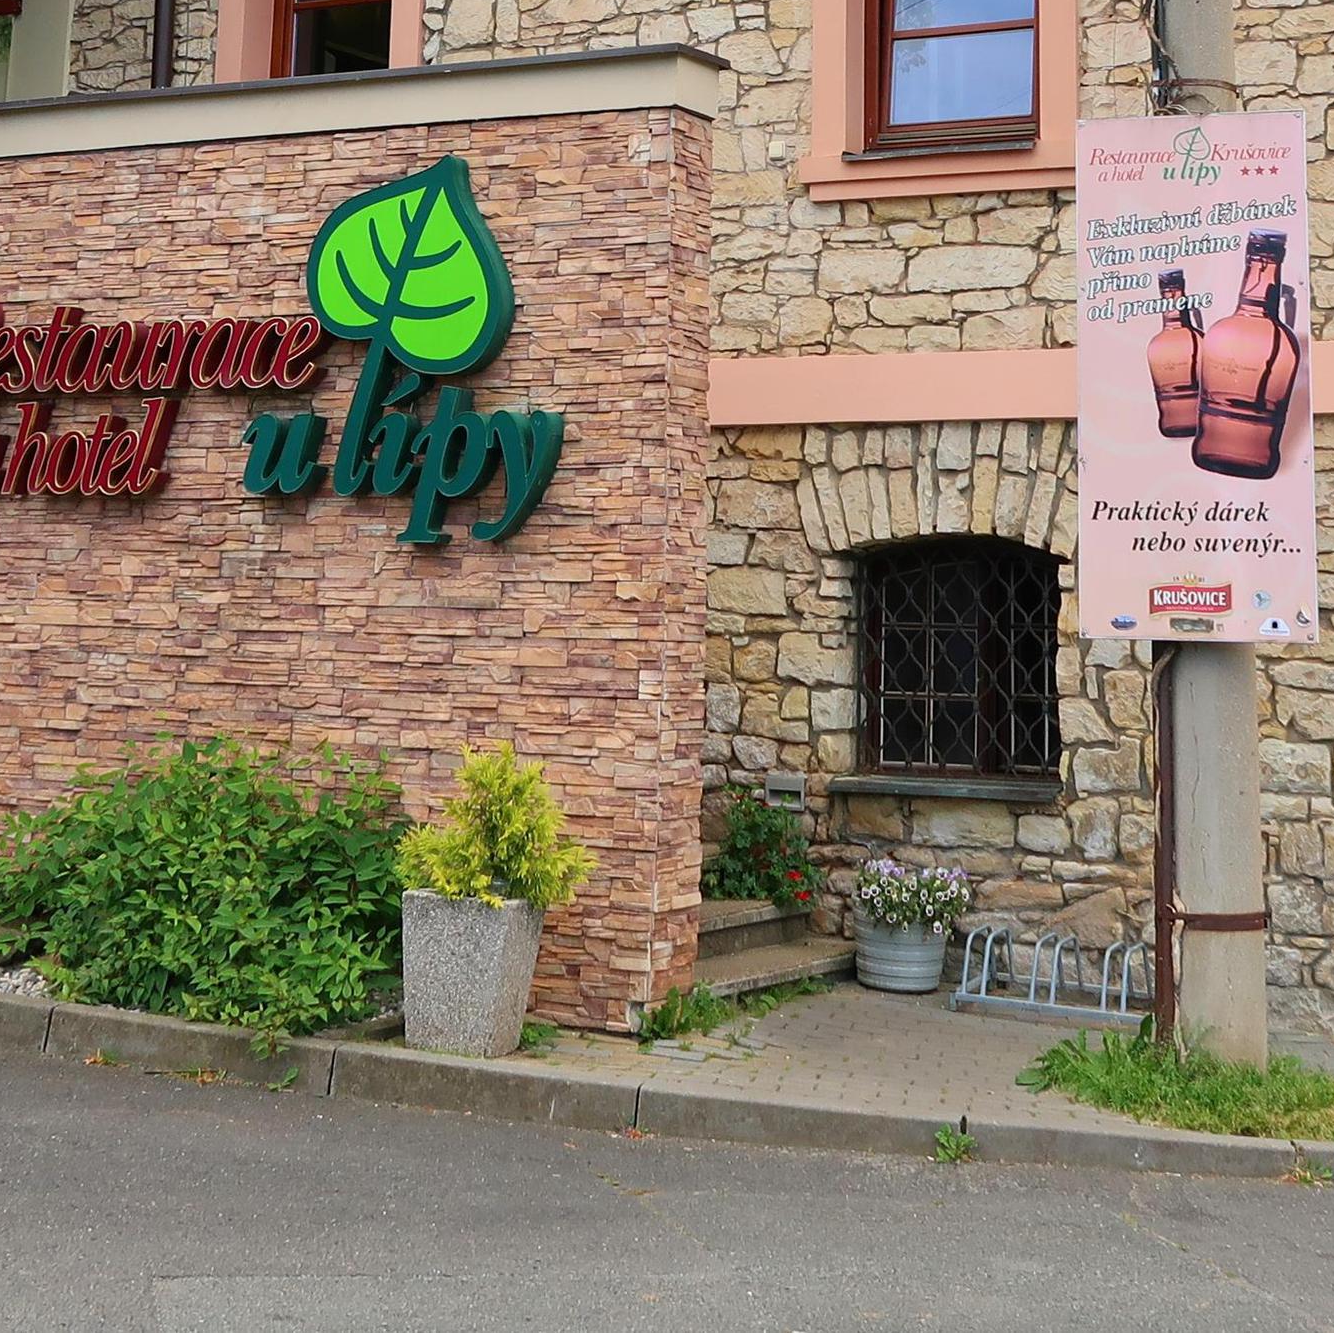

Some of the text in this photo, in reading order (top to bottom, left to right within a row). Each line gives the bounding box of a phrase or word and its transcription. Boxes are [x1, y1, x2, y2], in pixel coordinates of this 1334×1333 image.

[1090, 141, 1291, 166] Restaurace Krušovice
[1098, 160, 1221, 186] a hotel u lípy
[1087, 195, 1297, 240] Exkluzivní džbánek
[1088, 231, 1241, 268] Vám naplníme
[1087, 270, 1152, 299] přímo
[1087, 291, 1213, 323] od pramene
[1, 398, 180, 496] hotel
[242, 409, 326, 497] u
[332, 351, 564, 544] lípy
[1091, 501, 1270, 526] Praktický dárek
[1132, 532, 1302, 558] nebo suvenýr...
[1153, 588, 1226, 606] KRUŠOVICE
